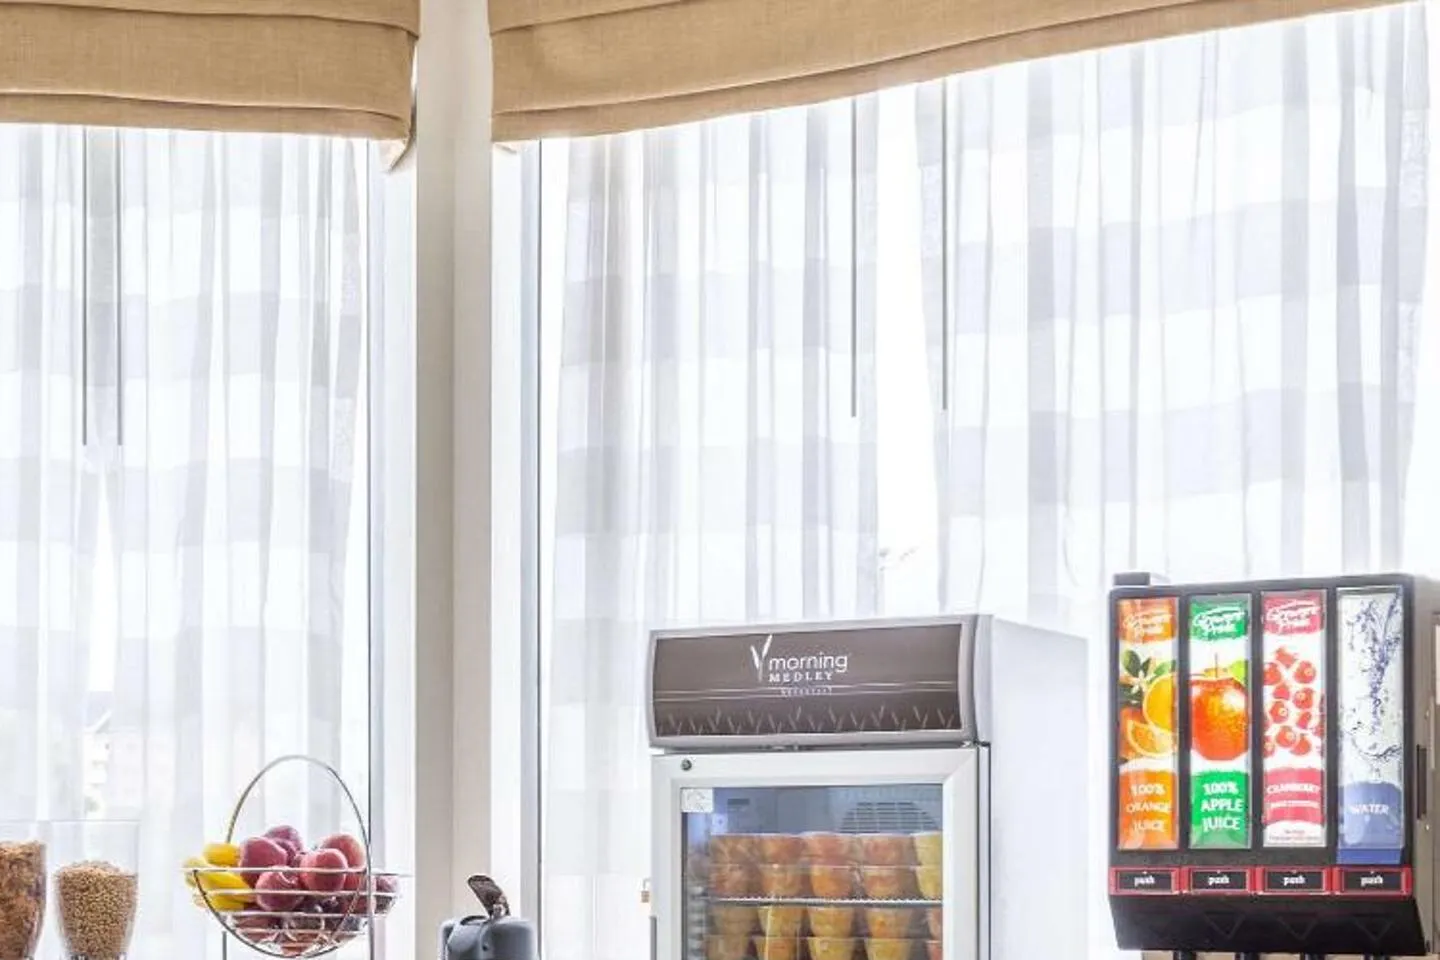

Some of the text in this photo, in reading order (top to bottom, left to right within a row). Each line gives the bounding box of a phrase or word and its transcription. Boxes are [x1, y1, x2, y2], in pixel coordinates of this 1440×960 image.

[768, 651, 848, 673] morning
[768, 671, 833, 682] MEDLEY
[1130, 783, 1166, 797] 100%
[1202, 781, 1240, 796] 100%
[1126, 801, 1172, 814] ORANGE
[1201, 798, 1244, 812] APPLE
[1348, 803, 1389, 815] WATER
[1133, 819, 1165, 833] JUICE
[1203, 816, 1241, 832] JUICE
[1134, 875, 1156, 886] push
[1208, 875, 1230, 886] push
[1283, 875, 1305, 886] push
[1361, 875, 1383, 886] push
